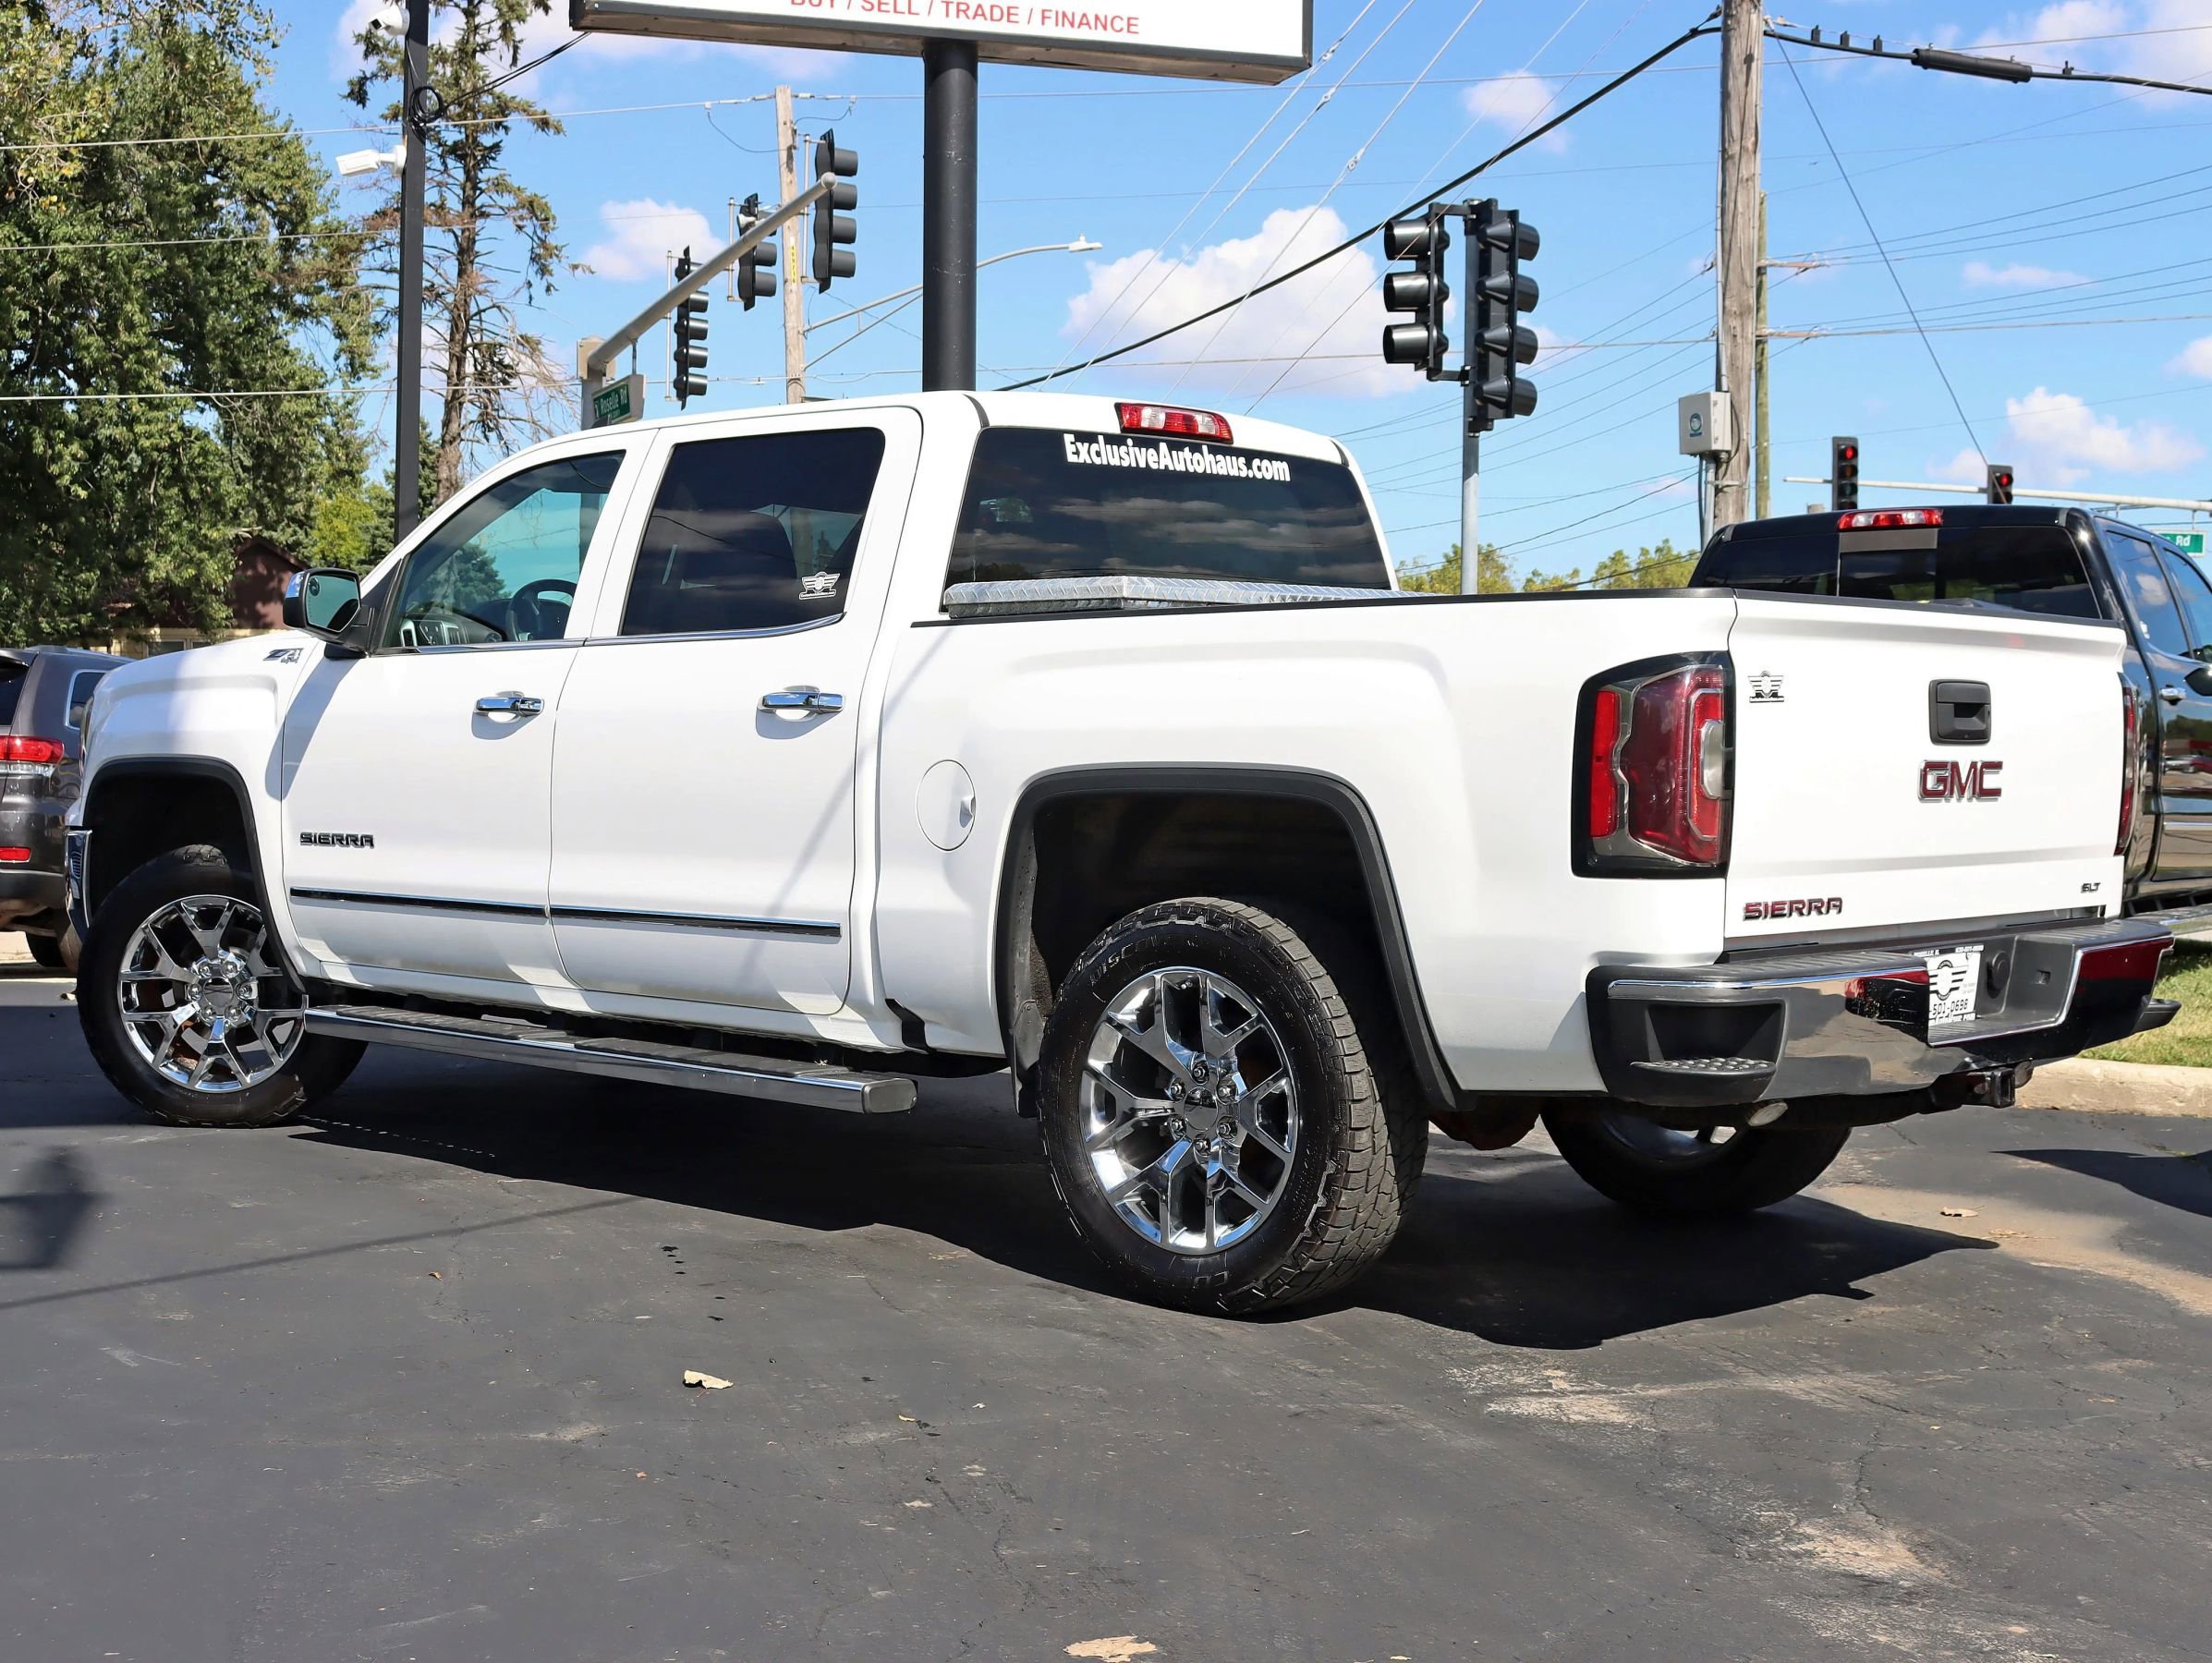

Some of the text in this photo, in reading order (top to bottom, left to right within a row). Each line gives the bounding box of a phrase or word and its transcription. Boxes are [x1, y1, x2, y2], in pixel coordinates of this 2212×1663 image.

[860, 0, 920, 16] SELL
[941, 0, 1020, 24] TRADE
[1041, 9, 1140, 34] FINANCE
[1063, 432, 1291, 482] ExclusiveAutohaus.com
[2175, 535, 2191, 547] Rd
[1918, 759, 2003, 803] GMC
[300, 832, 375, 850] SIERRA
[1743, 897, 1843, 921] SIERRA
